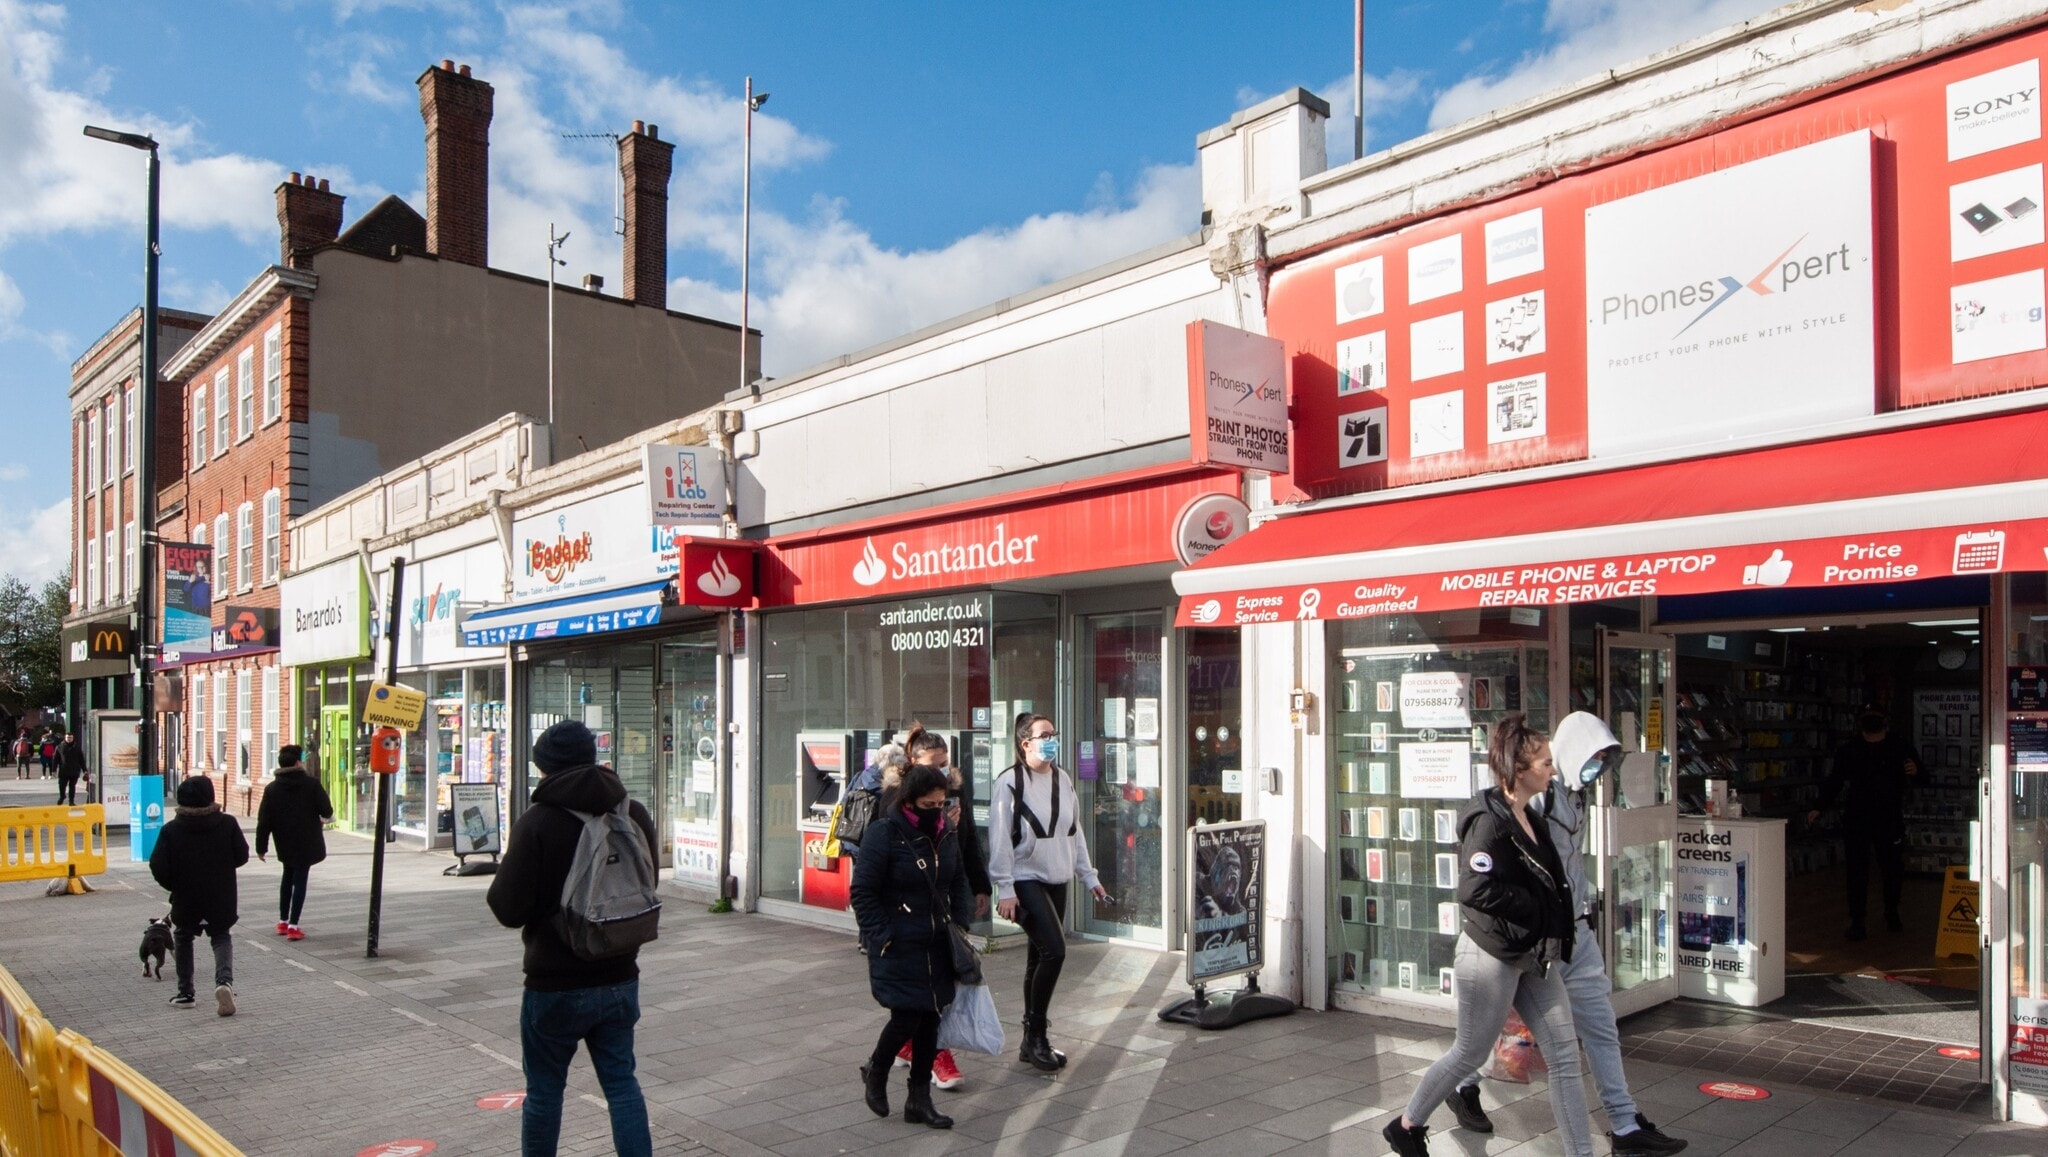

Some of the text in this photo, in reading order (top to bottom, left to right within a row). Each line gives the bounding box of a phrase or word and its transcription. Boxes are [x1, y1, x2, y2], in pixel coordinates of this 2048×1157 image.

[1954, 87, 2036, 121] SONY
[1669, 343, 1699, 357] YOUR
[1709, 334, 1748, 349] PHONE
[1758, 325, 1792, 338] WITH
[1803, 314, 1847, 330] STYLE
[1208, 417, 1288, 446] PRINT PHOTOS
[1208, 432, 1288, 456] STRAIGHT FROM YOUR
[1237, 448, 1263, 461] PHONE
[658, 502, 691, 510] Repairing
[166, 547, 210, 559] FIGHT
[891, 523, 1039, 580] Santander
[1843, 542, 1902, 561] Price
[166, 558, 195, 572] FLU
[1440, 554, 1717, 592] MOBILE PHONE & LAPTOP
[1824, 561, 1919, 583] Promise
[579, 576, 606, 586] Accessories
[1355, 583, 1405, 600] Quality
[1479, 578, 1657, 607] REPAIR SERVICES
[1236, 595, 1283, 610] Express
[1337, 596, 1418, 618] Guaranteed
[296, 596, 342, 632] Barnardo's
[880, 598, 983, 627] santander.co.uk
[1235, 610, 1279, 624] Service
[891, 627, 984, 652] 0800 030 4321
[1404, 698, 1464, 707] 07956884777
[369, 712, 414, 728] WARNING
[1677, 829, 1732, 846] racked
[1677, 847, 1732, 862] creens
[1690, 866, 1729, 876] TRANSFER
[1678, 892, 1731, 906] PAIRS ONLY
[1678, 954, 1711, 968] AIRED
[1712, 959, 1744, 972] HERE
